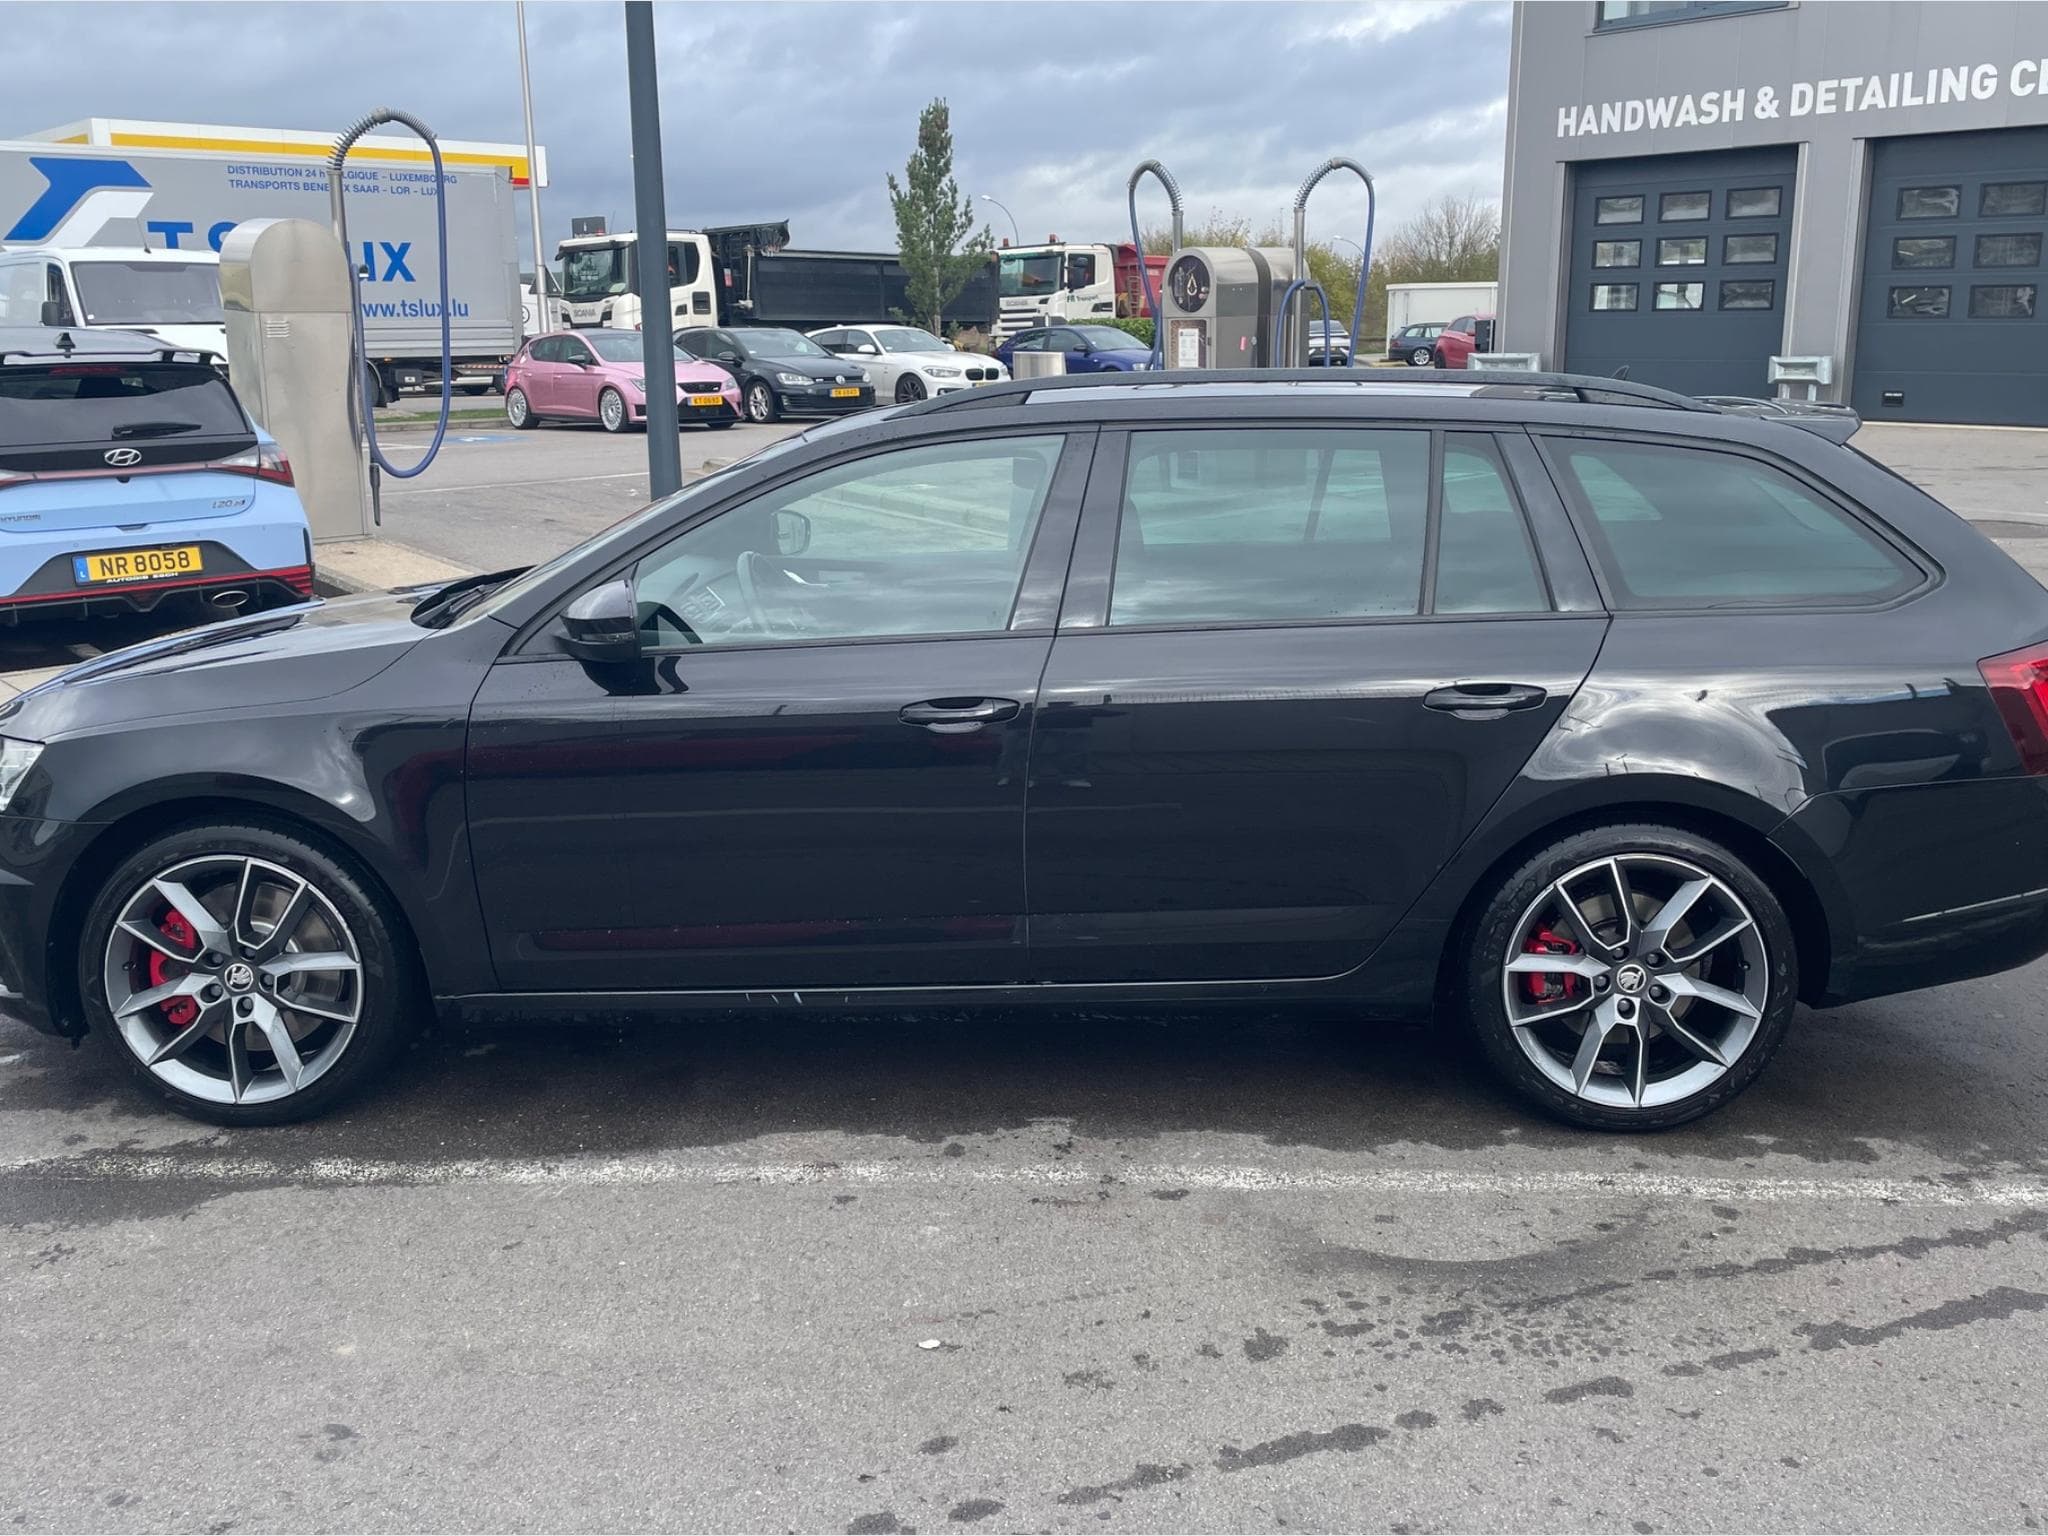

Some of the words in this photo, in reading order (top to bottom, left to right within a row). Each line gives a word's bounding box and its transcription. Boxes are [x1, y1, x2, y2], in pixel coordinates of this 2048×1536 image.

[1556, 88, 1746, 138] HANDWASH
[1753, 85, 1781, 120] &
[1789, 63, 1998, 117] DETAILING
[227, 165, 303, 177] DISTRIBUTION
[304, 169, 317, 178] 24
[389, 172, 458, 184] LUXEMBORG
[229, 179, 301, 191] TRANSPORTS
[302, 181, 351, 193] BENEX
[353, 183, 380, 194] SAAR
[390, 186, 411, 195] LOR
[99, 556, 129, 577] NR
[134, 550, 191, 573] 8058
